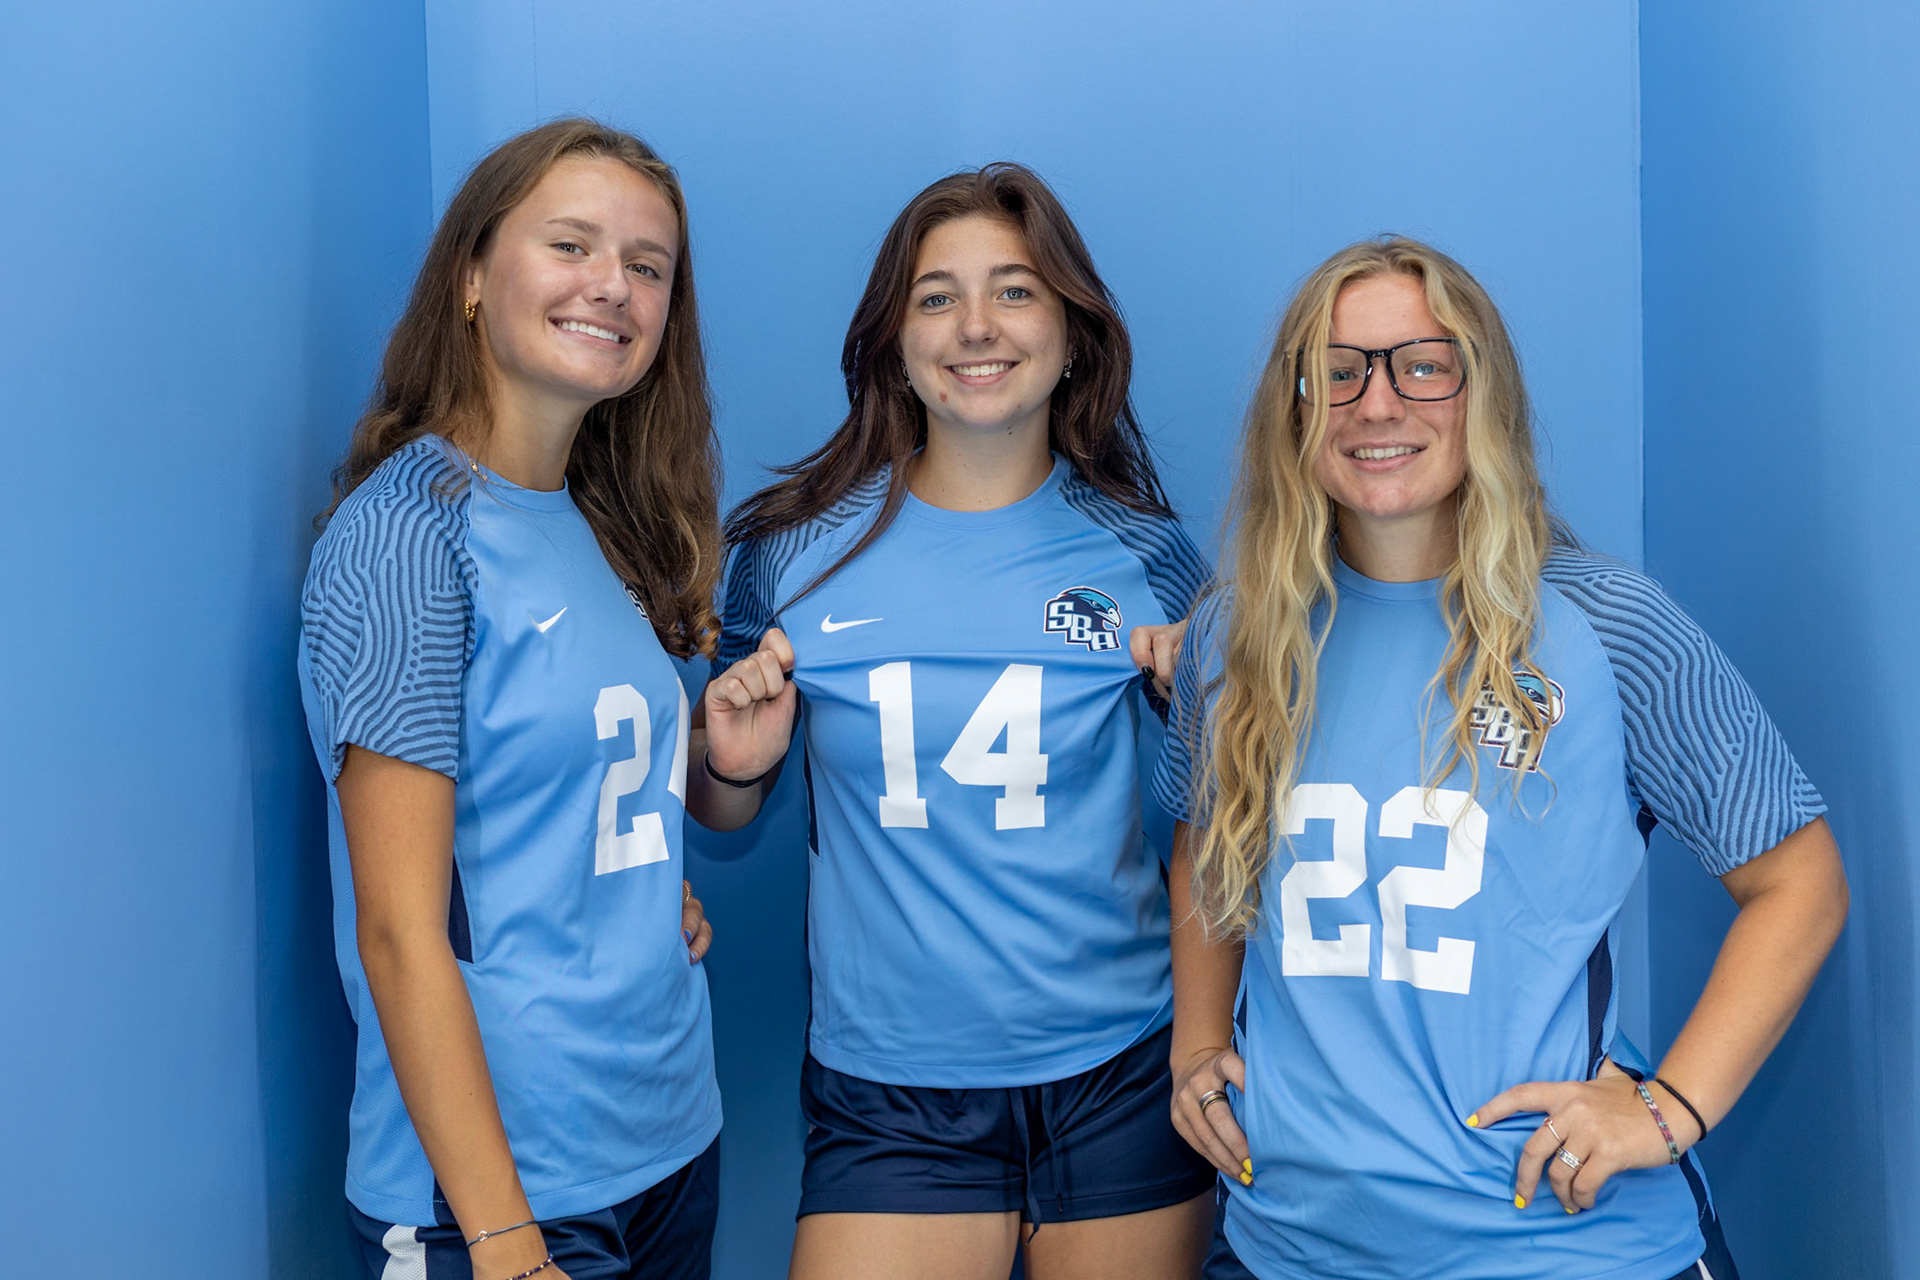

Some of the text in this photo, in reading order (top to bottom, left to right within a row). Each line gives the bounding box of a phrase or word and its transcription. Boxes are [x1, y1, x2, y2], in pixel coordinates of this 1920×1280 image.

[1048, 601, 1117, 651] SBA
[868, 661, 1049, 830] 14
[1280, 783, 1489, 995] 22
